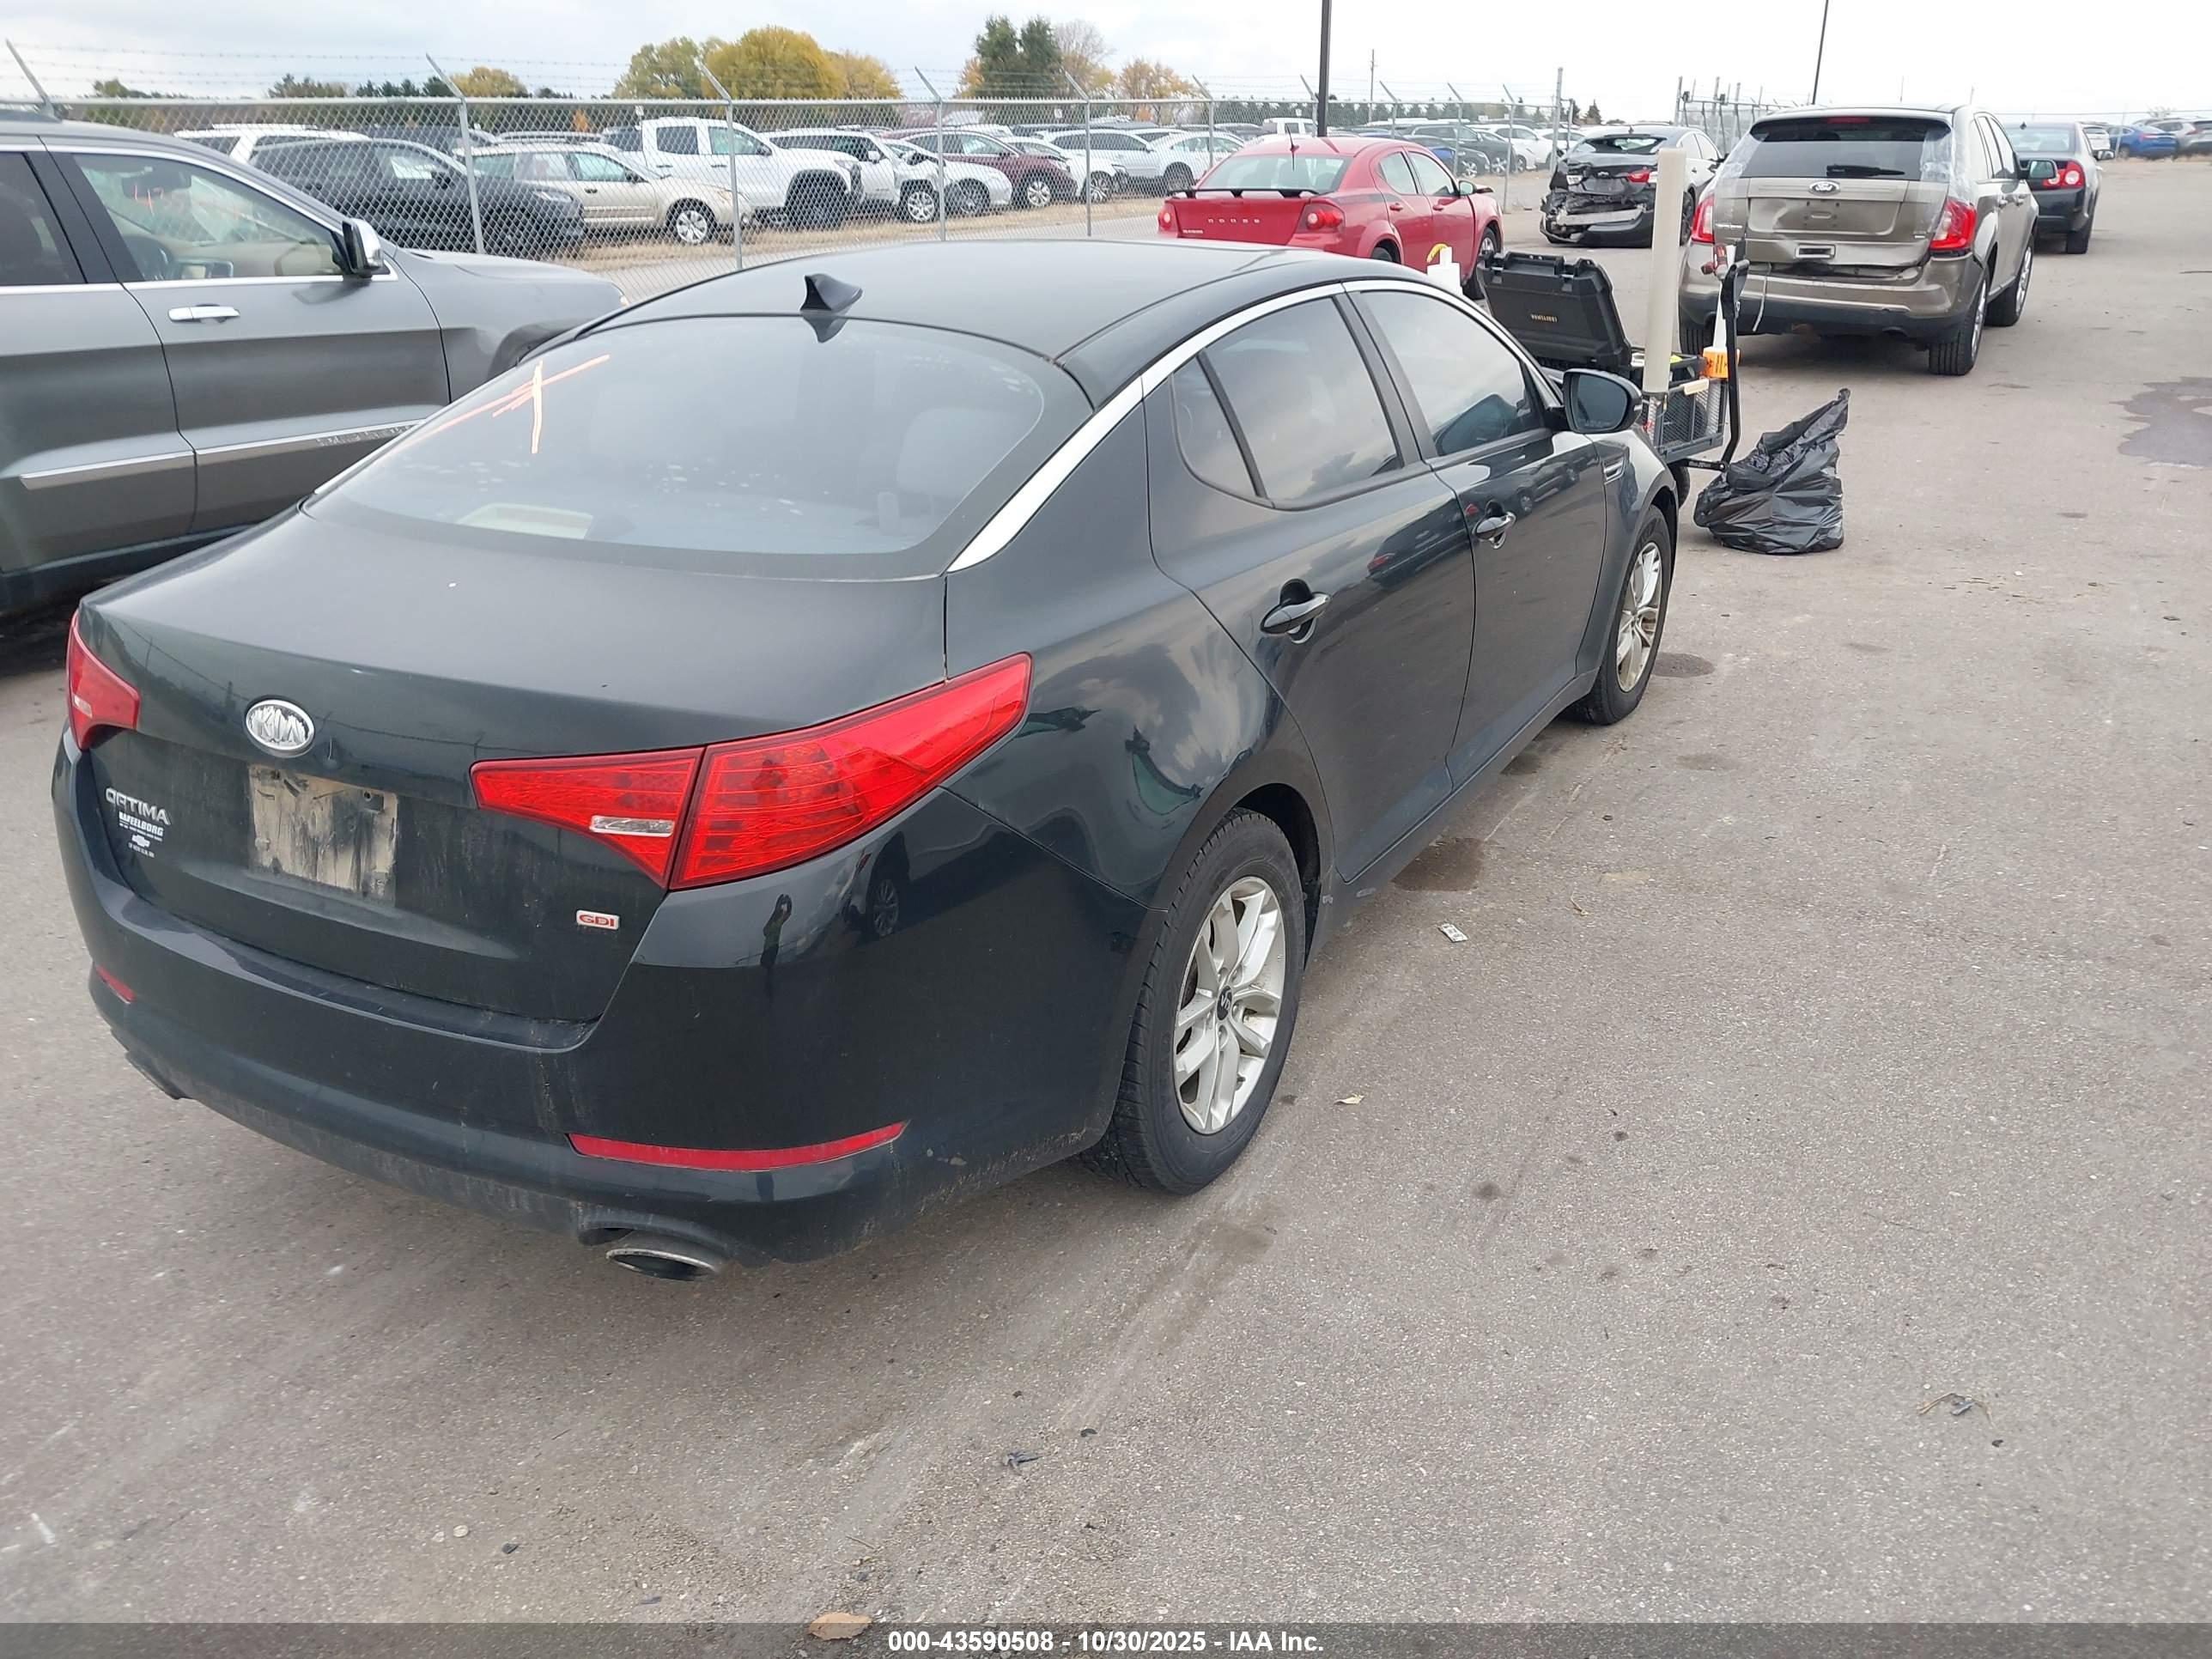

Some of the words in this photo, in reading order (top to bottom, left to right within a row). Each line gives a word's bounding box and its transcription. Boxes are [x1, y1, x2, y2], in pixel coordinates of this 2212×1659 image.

[249, 704, 309, 746] KIA
[106, 787, 171, 825] OPTIMA
[579, 914, 615, 927] GDI
